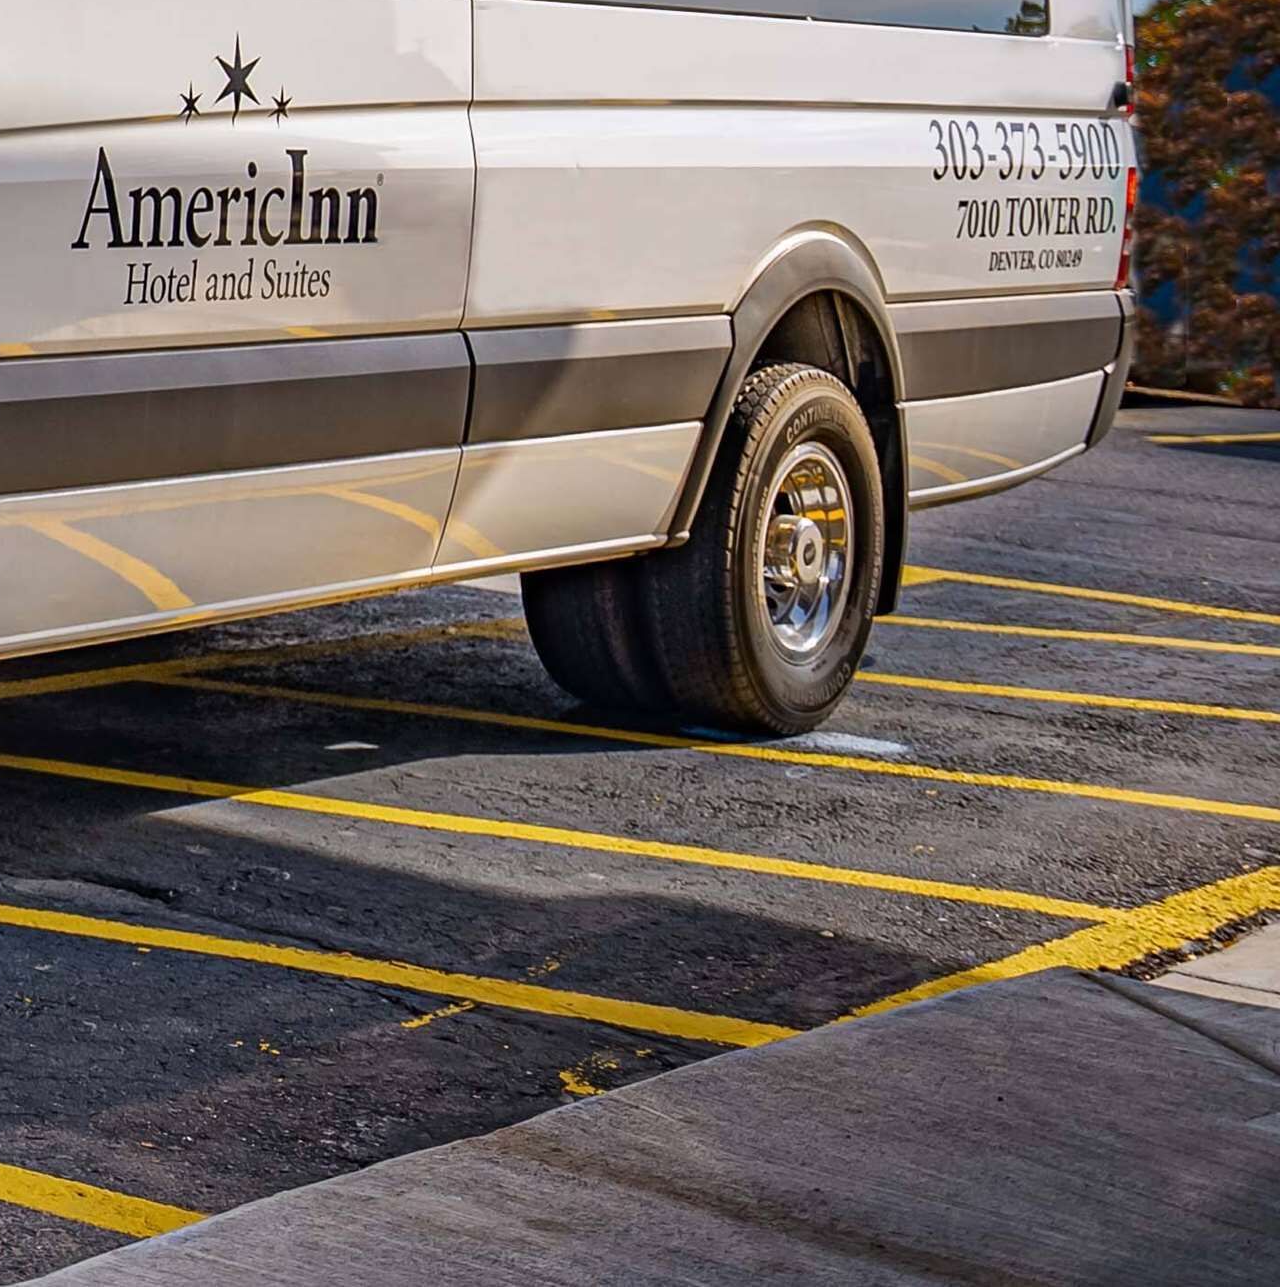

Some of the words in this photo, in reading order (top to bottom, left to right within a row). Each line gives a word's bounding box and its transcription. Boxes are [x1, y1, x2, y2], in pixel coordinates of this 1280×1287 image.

[929, 119, 1120, 181] 303-373-5900
[956, 200, 1001, 239] 7010
[1005, 197, 1080, 237] TOWER
[1084, 196, 1116, 235] RD.
[123, 258, 199, 305] Hotel
[205, 257, 254, 302] and
[260, 259, 332, 298] Suites
[988, 250, 1036, 272] DENVER,
[1039, 249, 1055, 270] CO
